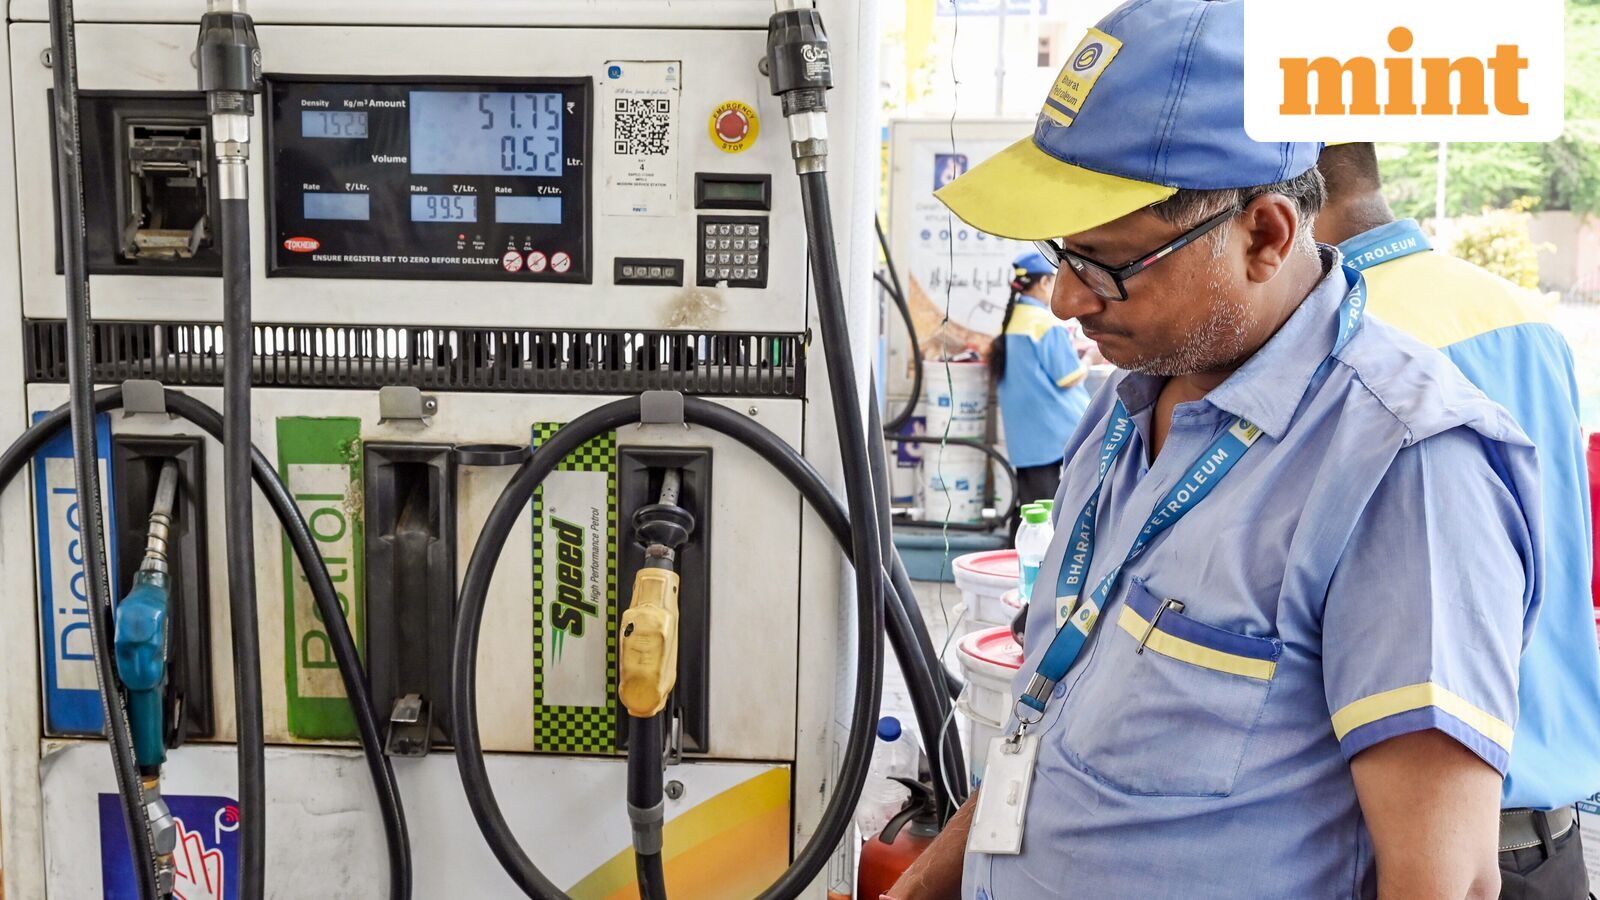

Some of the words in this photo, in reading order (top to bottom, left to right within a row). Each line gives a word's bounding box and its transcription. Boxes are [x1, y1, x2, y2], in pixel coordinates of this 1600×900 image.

[301, 99, 330, 108] Density
[369, 99, 407, 108] Amount
[478, 93, 560, 130] 51.75
[712, 102, 755, 119] EMERGENCY
[501, 135, 560, 172] 0.52
[721, 142, 744, 151] STOP
[371, 154, 408, 164] Volume
[566, 157, 584, 167] Ltr.
[303, 182, 321, 191] Rate
[410, 184, 428, 193] Rate
[494, 185, 513, 194] Rate
[312, 254, 342, 262] ENSURE
[343, 255, 381, 263] REGISTER
[382, 255, 396, 263] SET
[410, 256, 430, 264] ZERO
[431, 256, 461, 264] BEFORE
[462, 257, 500, 265] DELIVERY
[1346, 236, 1417, 270] ETROLEUM
[1143, 447, 1230, 535] PETROLEUM
[590, 506, 600, 532] Petrol
[590, 532, 600, 584] Performance
[1065, 523, 1091, 585] BHARAT
[550, 515, 598, 638] Speed
[590, 585, 601, 603] High
